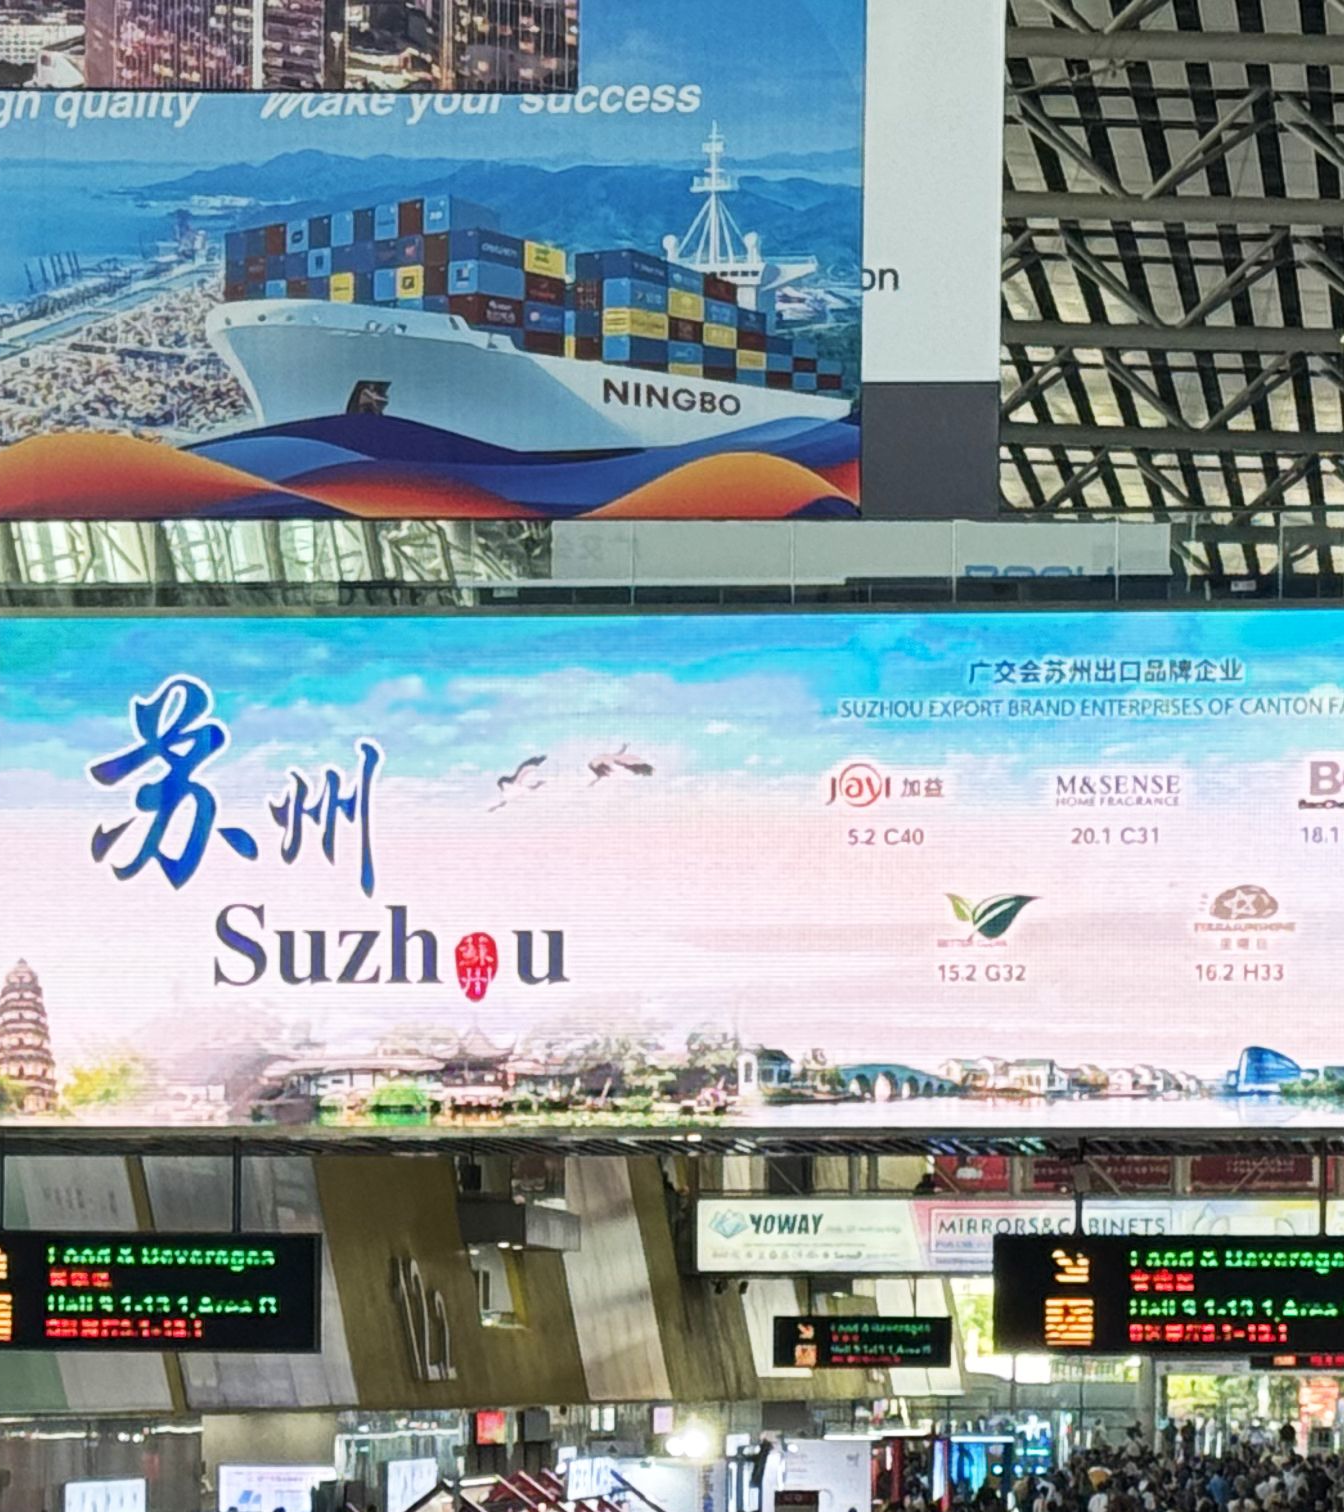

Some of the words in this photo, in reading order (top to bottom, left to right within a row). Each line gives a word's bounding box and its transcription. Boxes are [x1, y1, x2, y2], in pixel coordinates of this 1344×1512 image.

[55, 92, 203, 129] quality
[520, 80, 703, 116] success
[601, 377, 742, 417] NINGBO
[969, 659, 1243, 685] 广交会苏州出口品牌企业
[840, 699, 924, 719] SUZHOU
[928, 699, 1003, 718] EXPORT
[1008, 699, 1076, 718] BRAND
[1080, 698, 1203, 717] ENTERPRISES
[1208, 697, 1234, 716] OF
[1240, 697, 1323, 716] CANTON
[90, 674, 386, 898] 苏州
[901, 777, 945, 799] 加益
[1056, 775, 1182, 797] M&SENSE
[1056, 796, 1096, 807] HOME
[1099, 796, 1180, 807] FRAGRANCE
[847, 828, 877, 846] 5.2
[884, 828, 925, 846] C40
[1070, 827, 1111, 845] 20.1
[1120, 827, 1160, 845] C31
[1299, 827, 1340, 844] 18.1
[937, 964, 977, 982] 15.2
[985, 964, 1027, 982] G32
[1194, 963, 1234, 982] 16.2
[1243, 963, 1285, 982] H33
[748, 1213, 824, 1236] YOWAY
[937, 1216, 1166, 1236] MIRRORS&CBINETS
